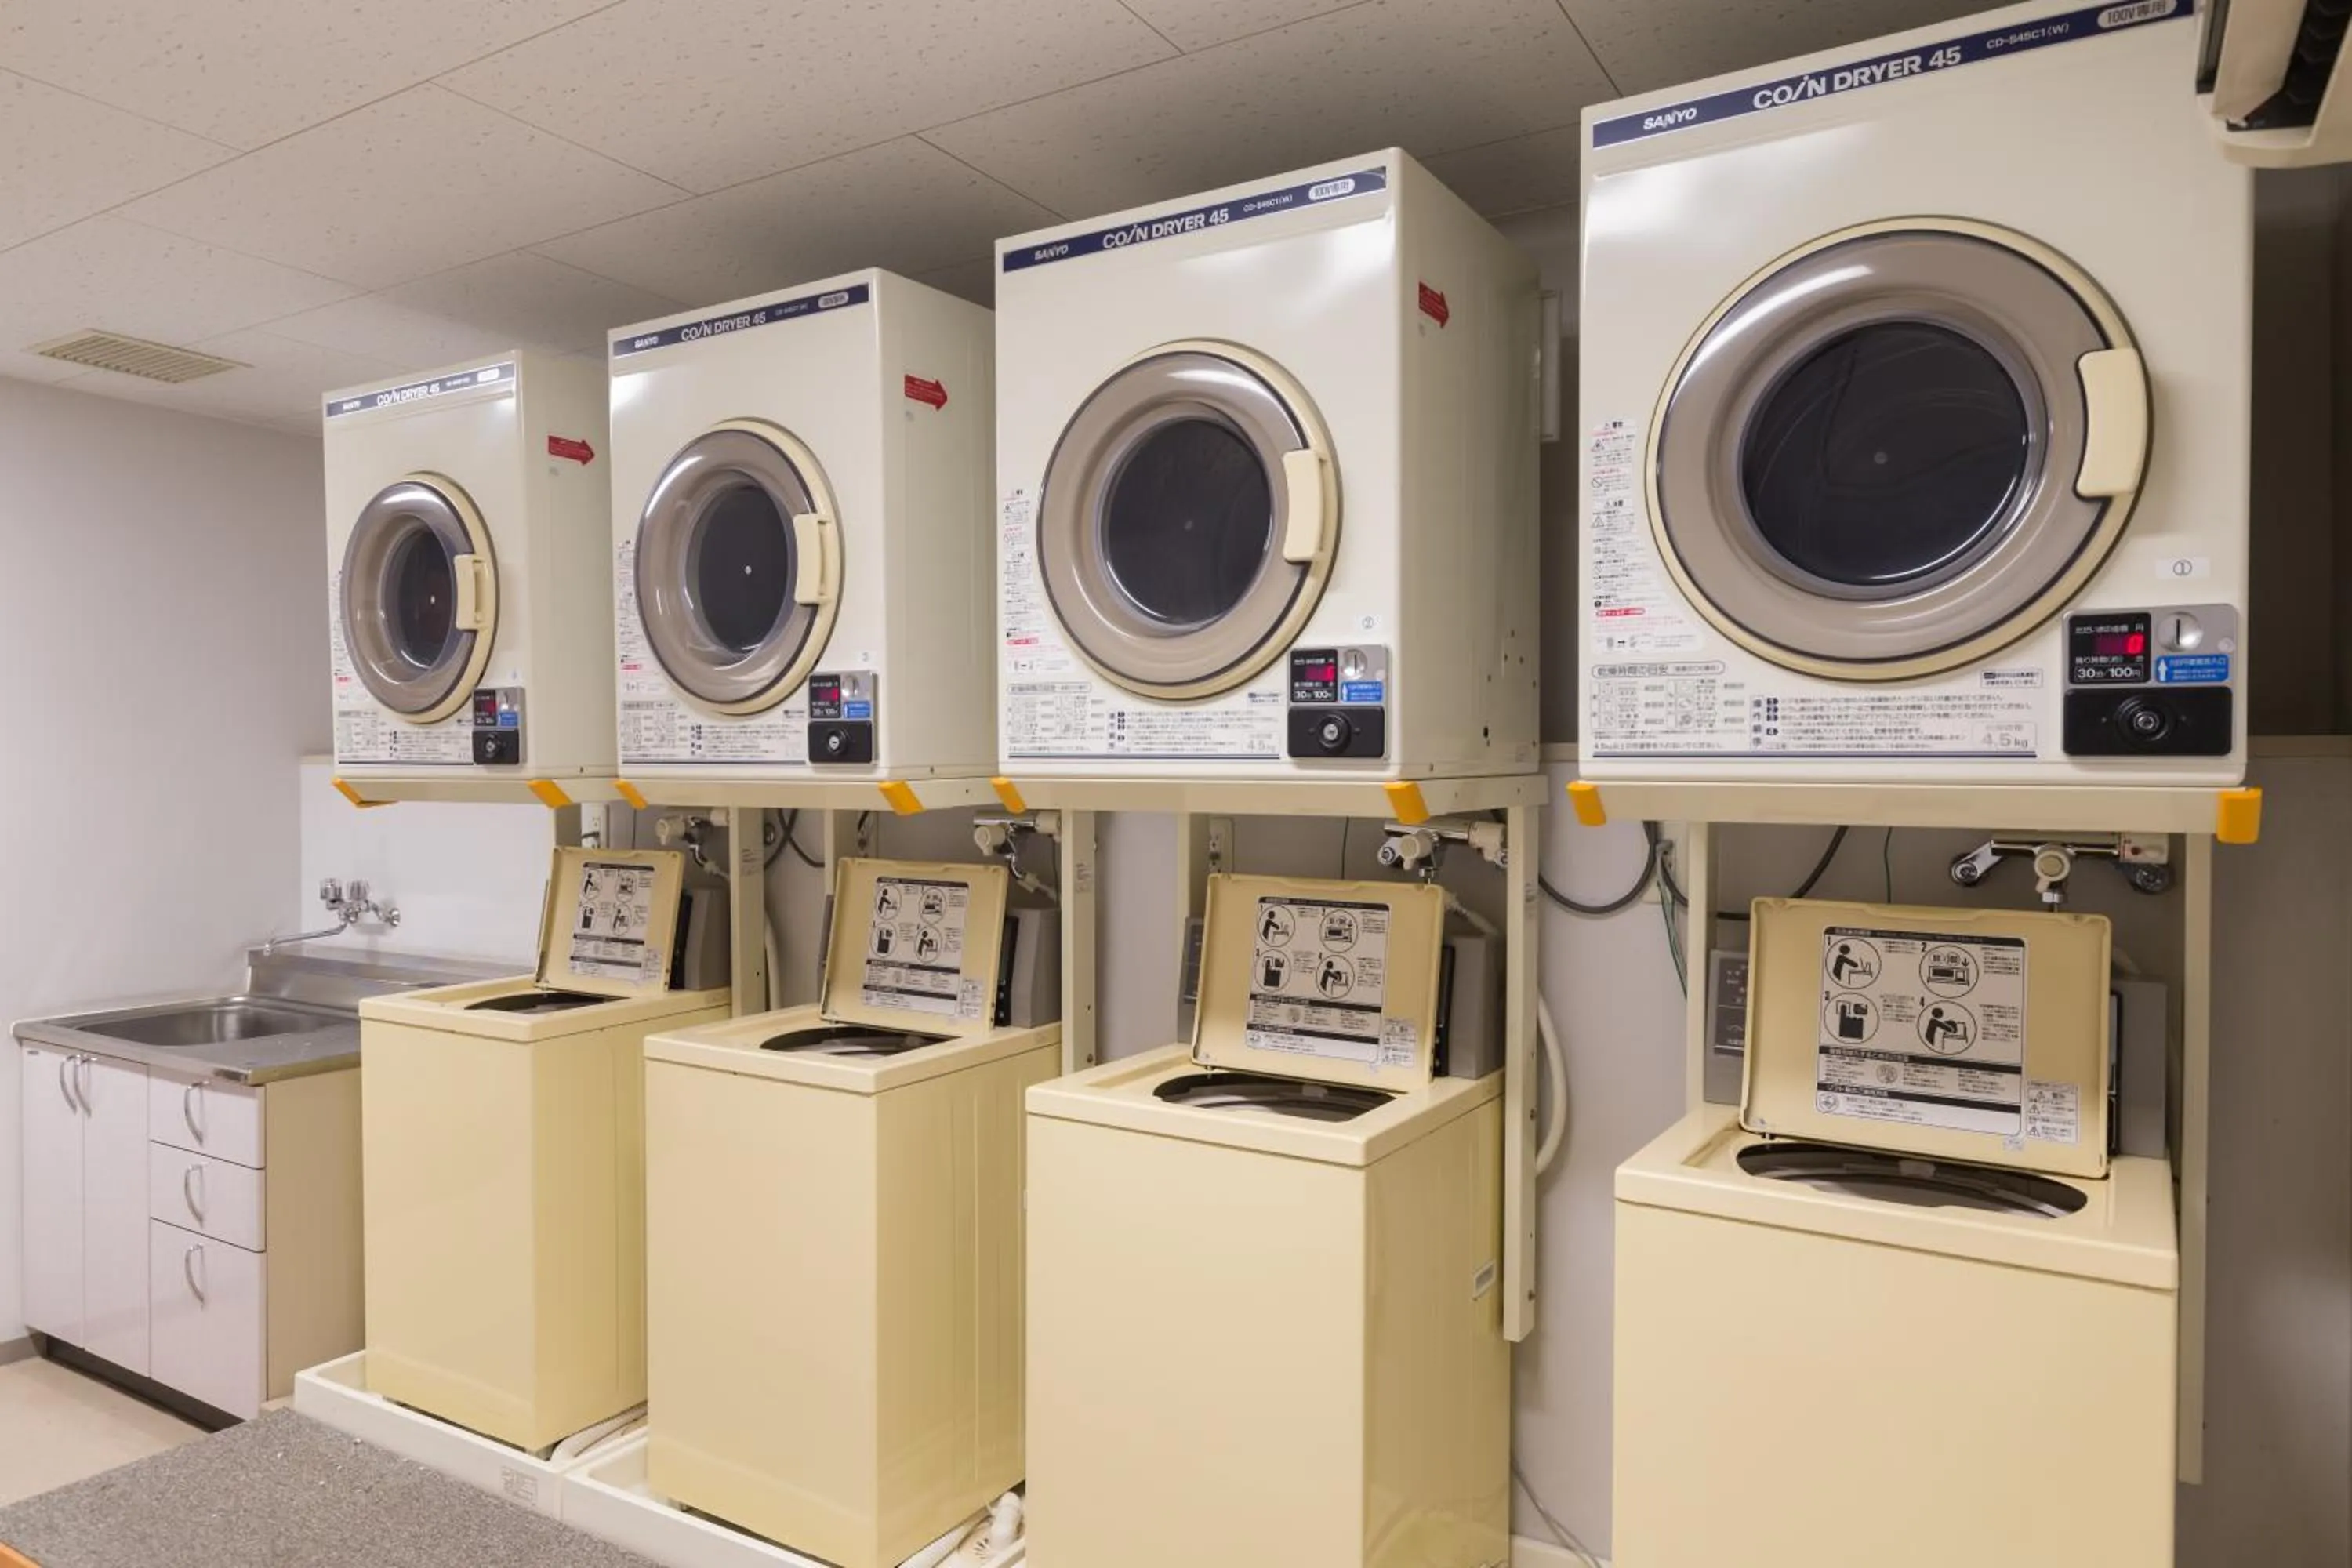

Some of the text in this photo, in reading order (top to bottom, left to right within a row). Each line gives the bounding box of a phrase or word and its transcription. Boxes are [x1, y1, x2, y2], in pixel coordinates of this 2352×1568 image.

[1833, 55, 1922, 91] DRYER
[1929, 45, 1962, 68] 45
[1643, 107, 1697, 130] SANYO
[1152, 213, 1205, 238] DRYER
[1209, 208, 1229, 224] 45
[1034, 245, 1069, 260] SANYO
[714, 314, 750, 335] DRYER
[1922, 942, 1926, 953] 2
